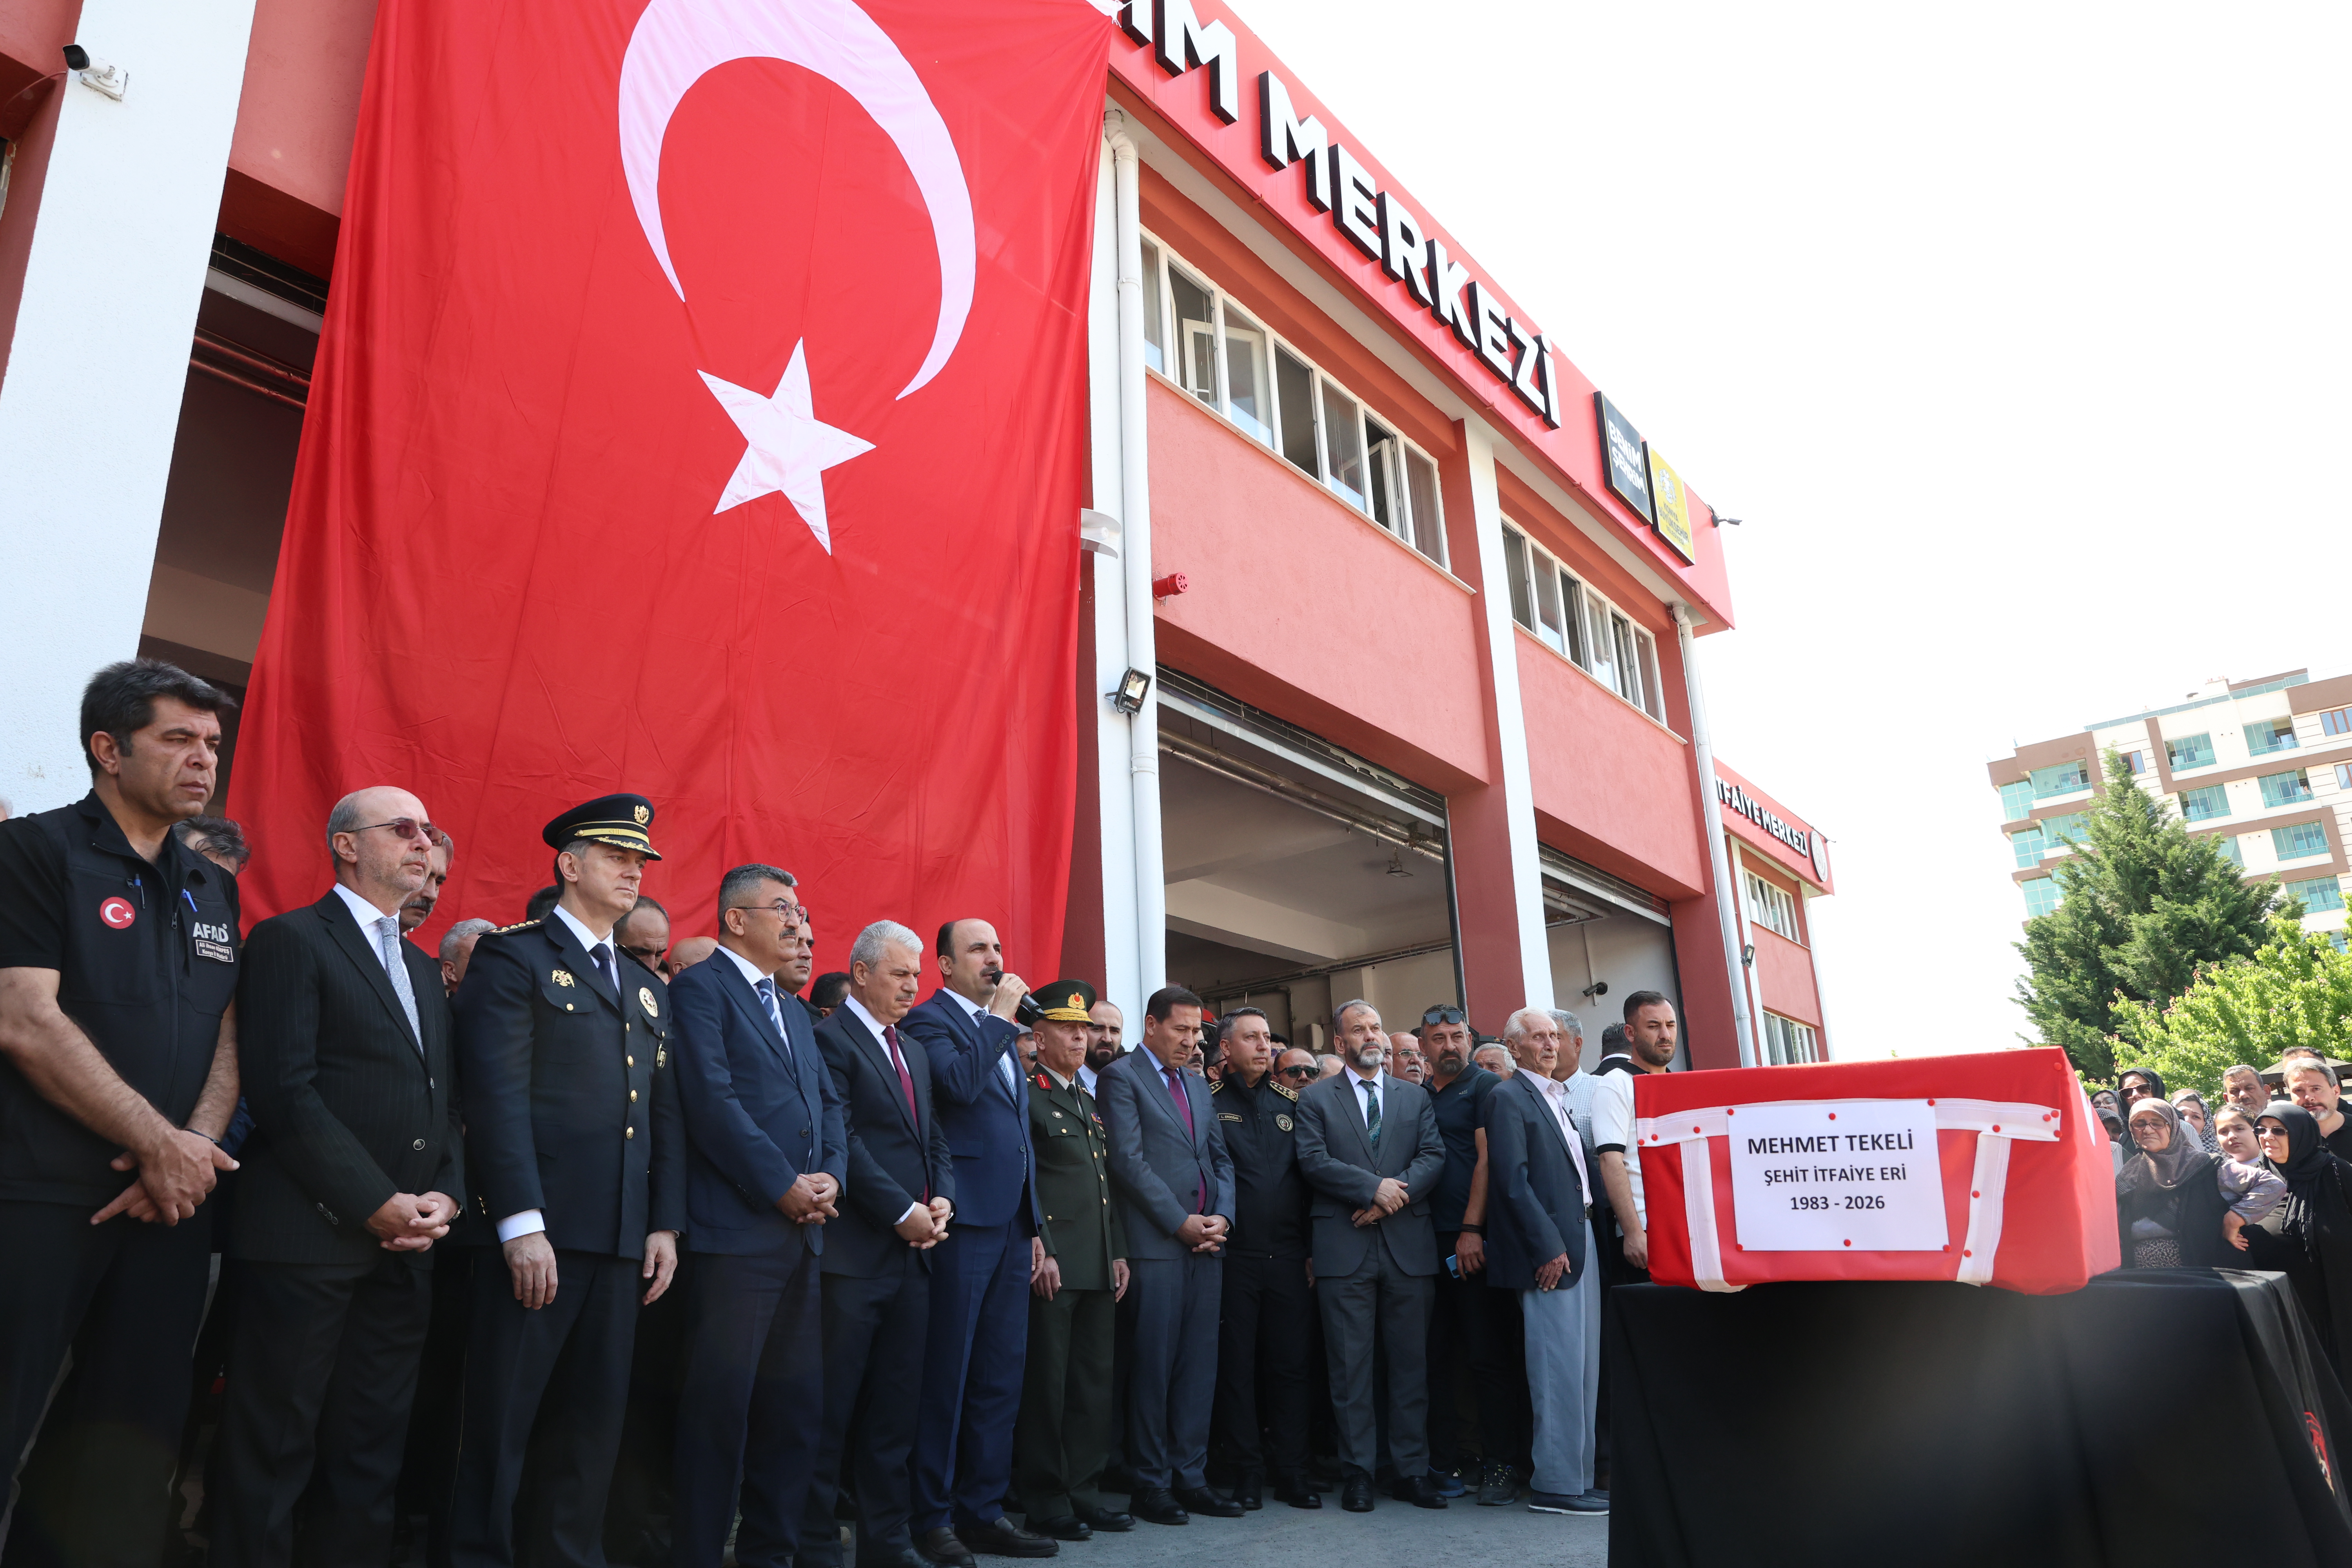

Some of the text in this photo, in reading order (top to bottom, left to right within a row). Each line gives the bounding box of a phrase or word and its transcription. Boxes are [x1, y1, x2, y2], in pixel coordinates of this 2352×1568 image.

[1259, 70, 1561, 430] MERKEZİ
[1608, 419, 1642, 473] BENİM
[1612, 446, 1646, 495] ŞEHRİM
[1658, 505, 1689, 543] BÜYÜKŞEHİR
[1664, 501, 1679, 523] KONYA
[1759, 807, 1809, 858] MERKEZİ
[193, 922, 229, 942] AFAD
[1748, 1129, 1913, 1154] MEHMET TEKELİ
[1764, 1163, 1906, 1186] ŞEHİT İTFAİYE ERİ
[1790, 1196, 1829, 1210] 1983
[1845, 1195, 1885, 1209] 2026
